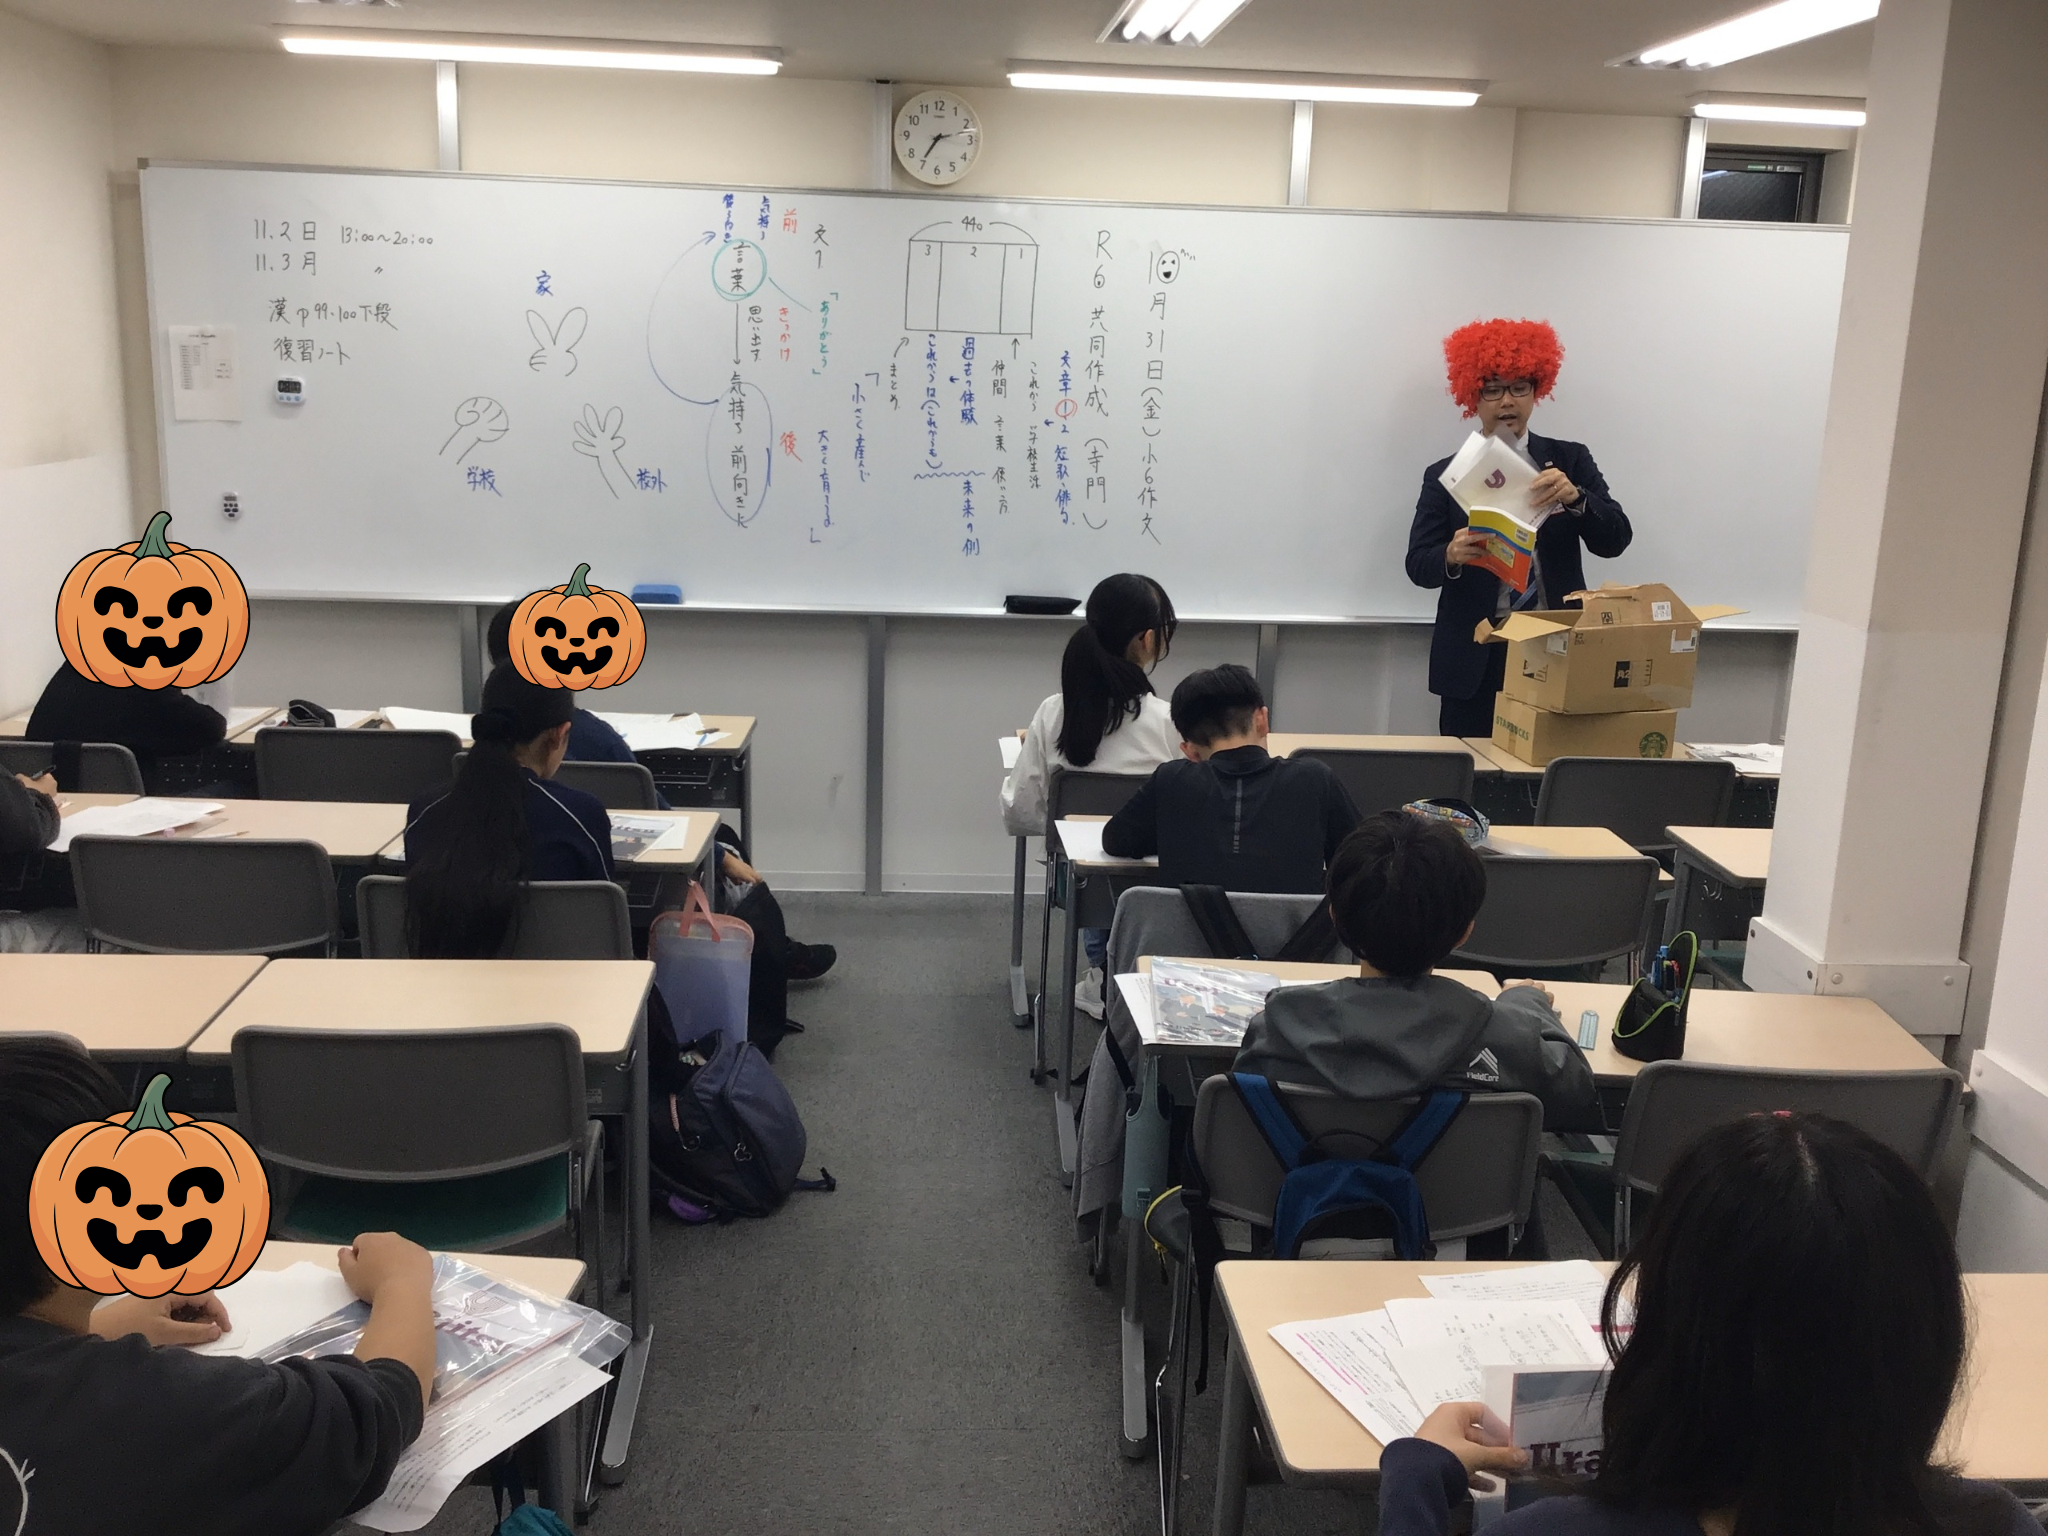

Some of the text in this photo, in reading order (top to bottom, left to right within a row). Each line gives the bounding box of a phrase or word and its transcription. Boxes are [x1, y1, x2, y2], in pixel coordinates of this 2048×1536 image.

[920, 104, 929, 114] 11
[934, 100, 945, 111] 12
[953, 106, 958, 116] 1
[909, 115, 920, 126] 10
[963, 118, 970, 129] 2
[903, 130, 910, 140] 9
[967, 135, 973, 145] 3
[908, 148, 915, 158] 8
[960, 152, 967, 161] 4
[920, 160, 926, 169] 7
[934, 165, 940, 175] 6
[949, 162, 956, 172] 5
[783, 208, 797, 234] 前
[961, 216, 982, 231] 440
[924, 245, 931, 256] 3
[970, 246, 977, 257] 2
[1019, 247, 1023, 259] 1
[731, 242, 750, 292] 言葉
[536, 271, 553, 297] 家
[748, 305, 763, 362] 思い出す
[779, 307, 791, 362] きっかけ
[274, 337, 350, 366] 復習ノート
[890, 363, 899, 410] まとめ
[991, 360, 1008, 514] 仲間 言葉 使い方
[728, 371, 748, 529] 気持ち 前向きに
[779, 431, 802, 463] 後
[467, 467, 502, 498] 学校
[636, 467, 668, 494] 校外
[1496, 715, 1530, 742] STARBUCKS
